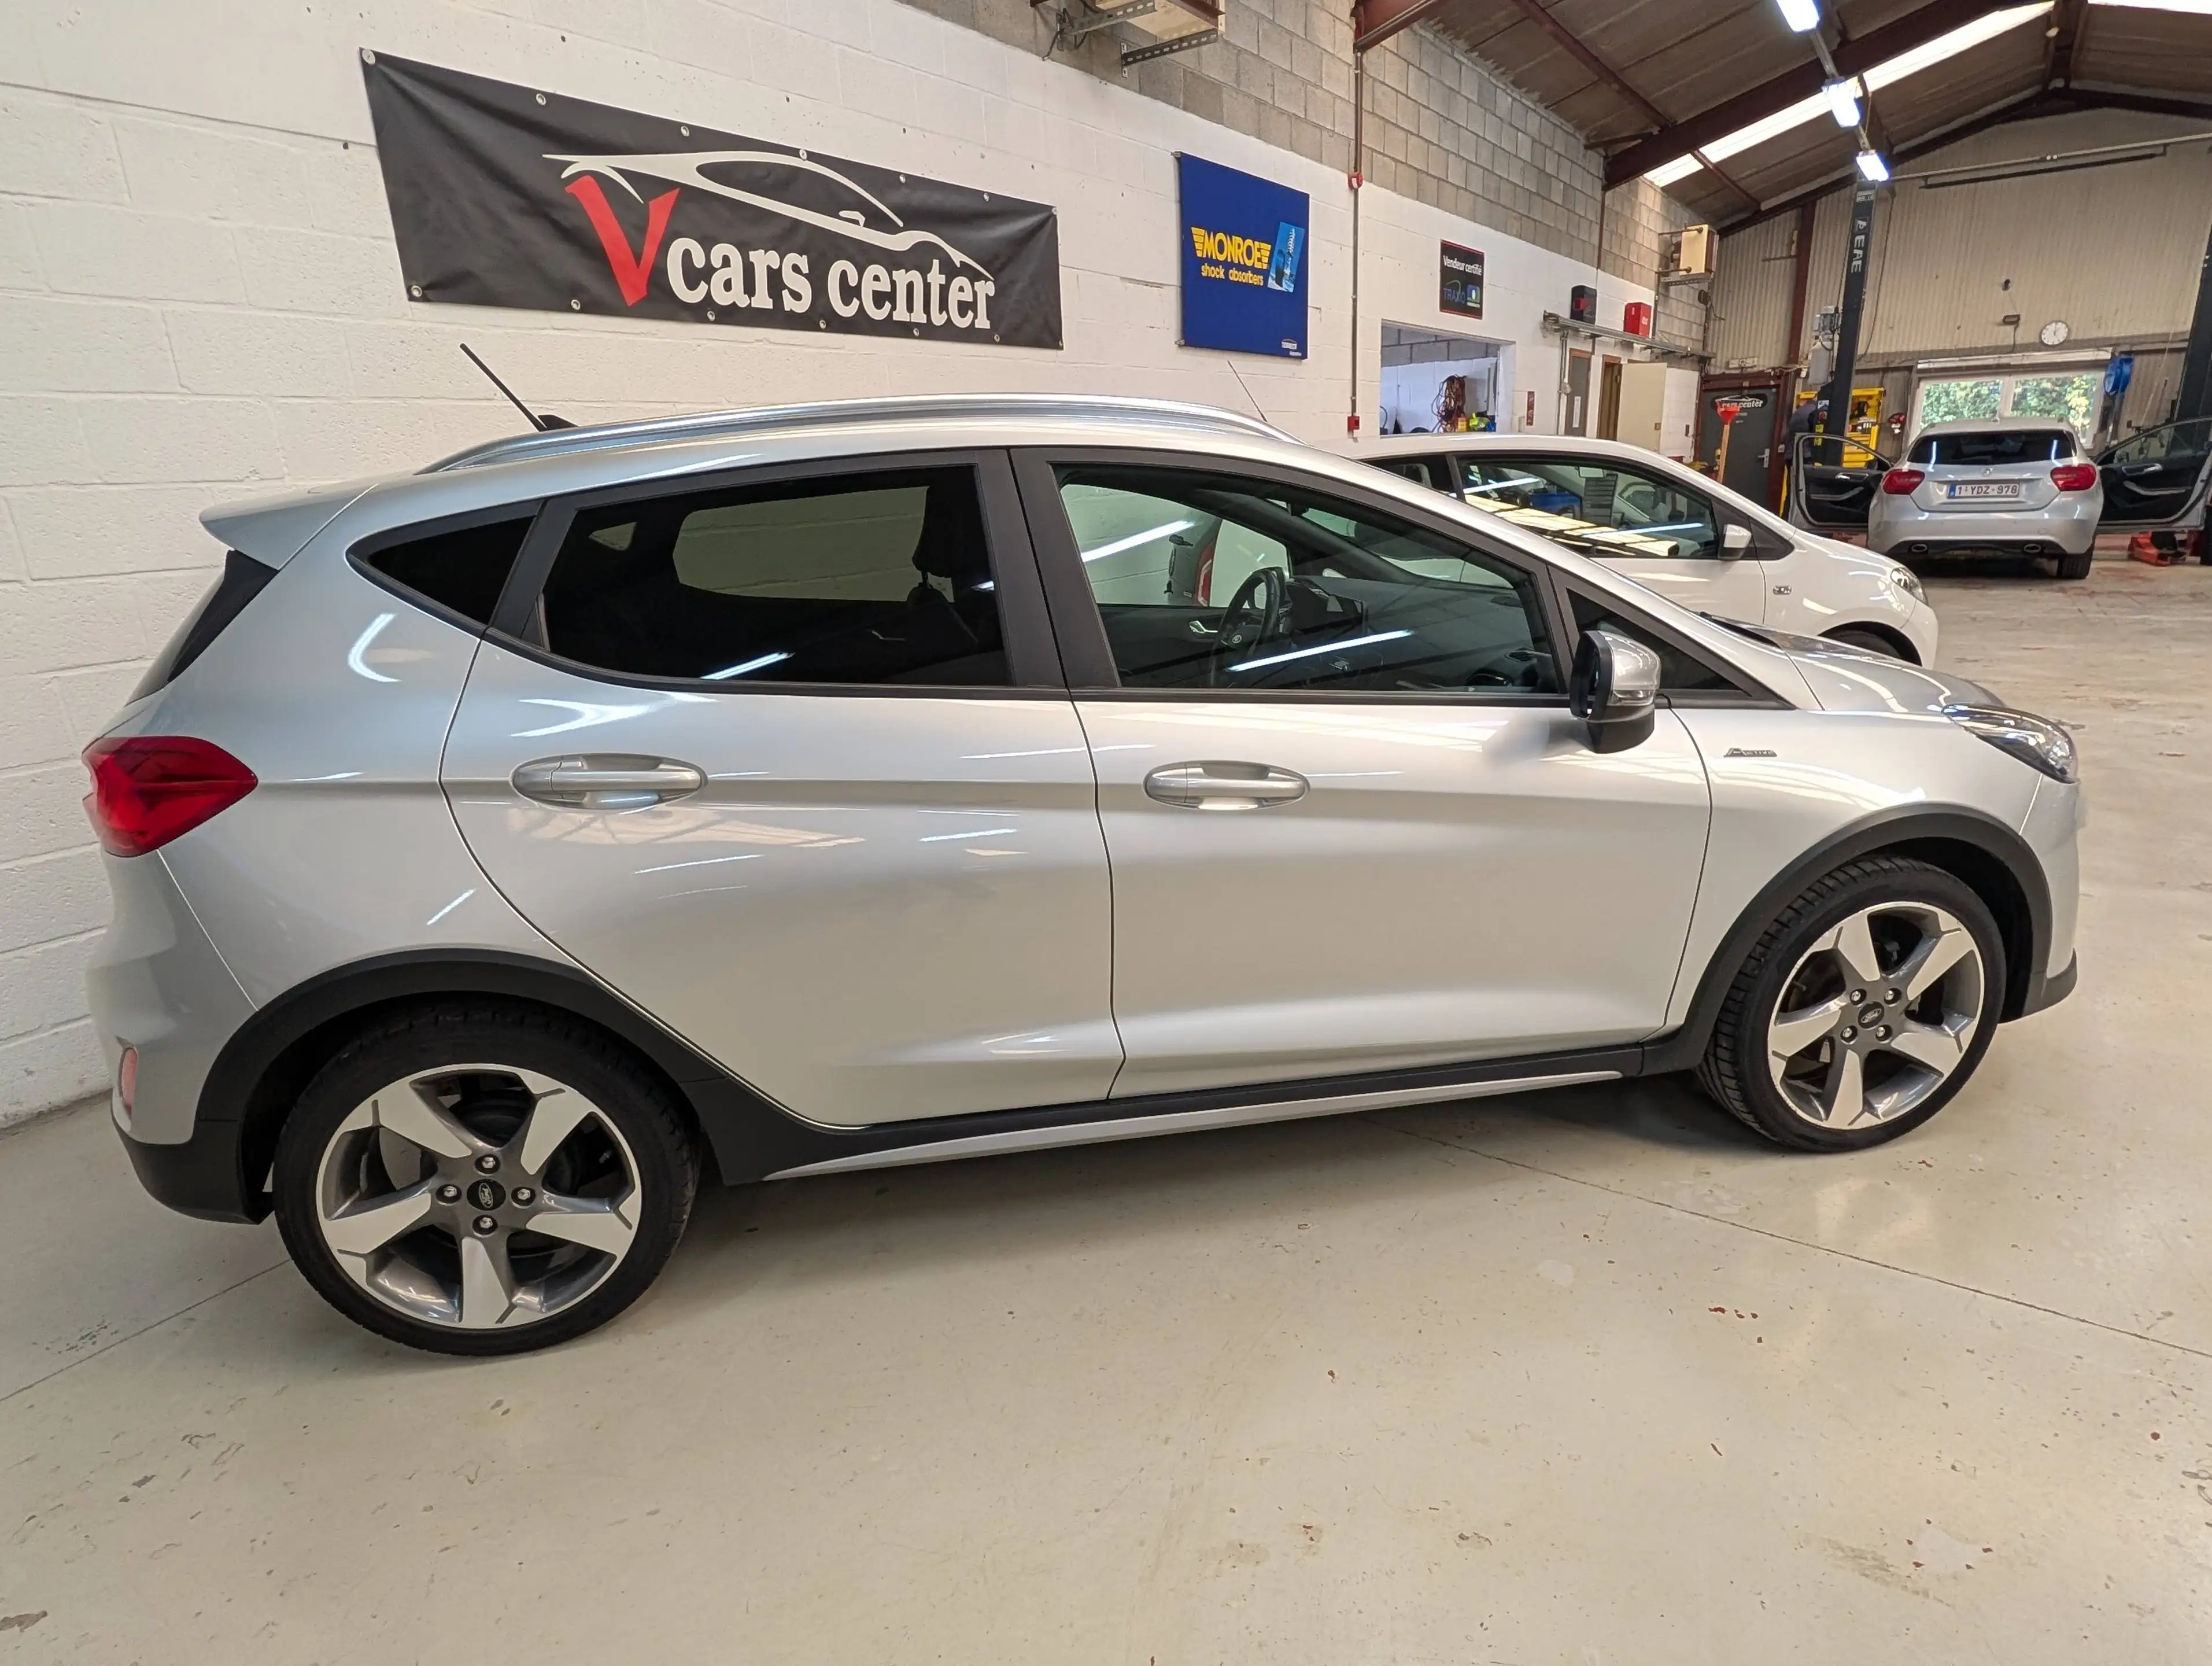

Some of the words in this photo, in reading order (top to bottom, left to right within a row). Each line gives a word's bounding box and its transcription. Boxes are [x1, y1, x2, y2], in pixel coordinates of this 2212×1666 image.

[1202, 230, 1264, 268] MONROE
[1443, 255, 1465, 271] Vendeur
[1465, 264, 1482, 275] certifié
[1851, 234, 1865, 273] EAE
[1201, 263, 1225, 279] shock
[1229, 268, 1264, 286] absorbers
[828, 259, 994, 329] center
